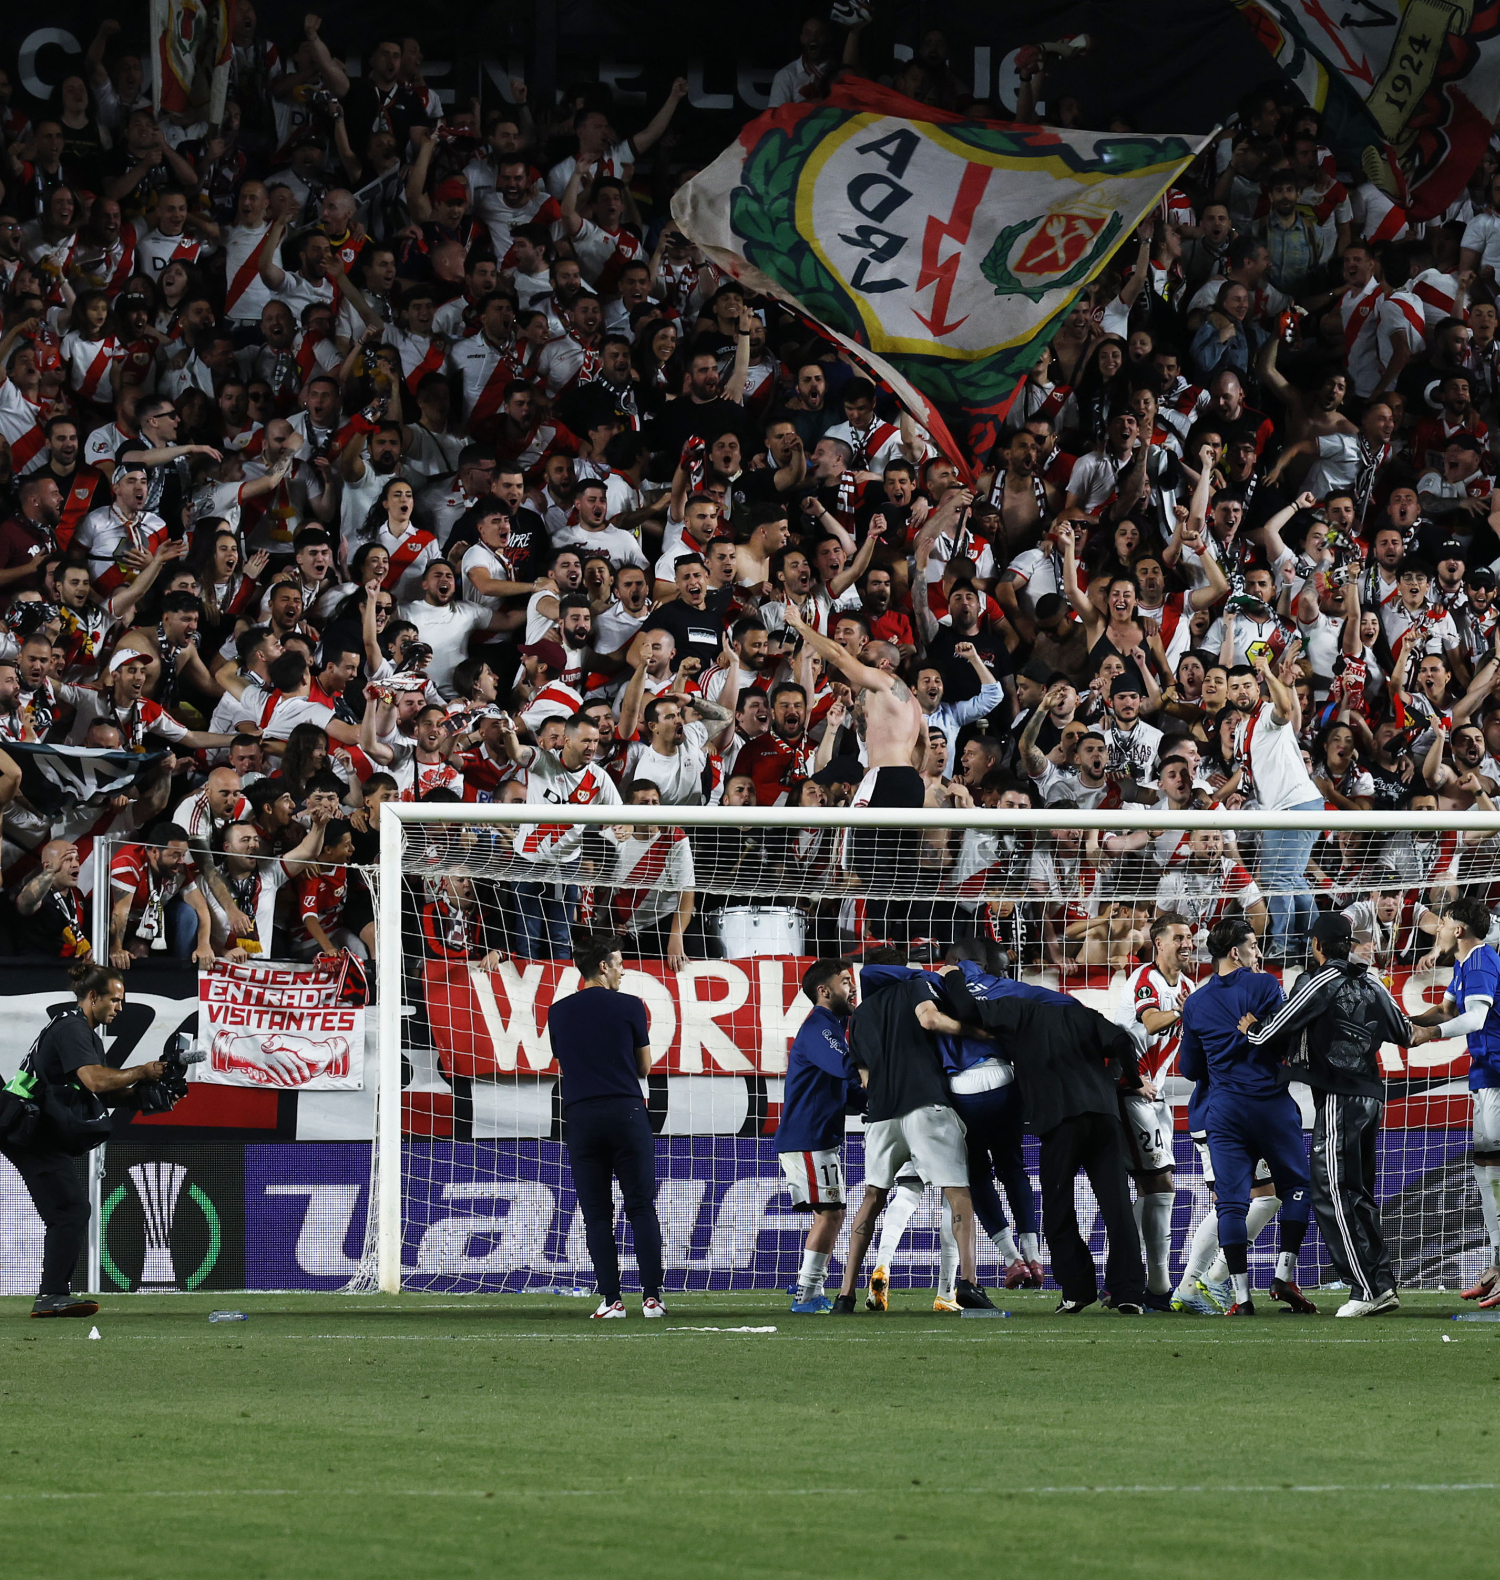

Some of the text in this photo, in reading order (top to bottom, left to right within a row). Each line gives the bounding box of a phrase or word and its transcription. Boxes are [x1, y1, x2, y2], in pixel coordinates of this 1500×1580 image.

[1384, 34, 1433, 111] 1924
[206, 961, 340, 986] ACUERD
[207, 980, 350, 1008] ENTRADA
[208, 1003, 356, 1032] VISITANTES
[1139, 1128, 1164, 1153] 24
[820, 1163, 840, 1187] 17
